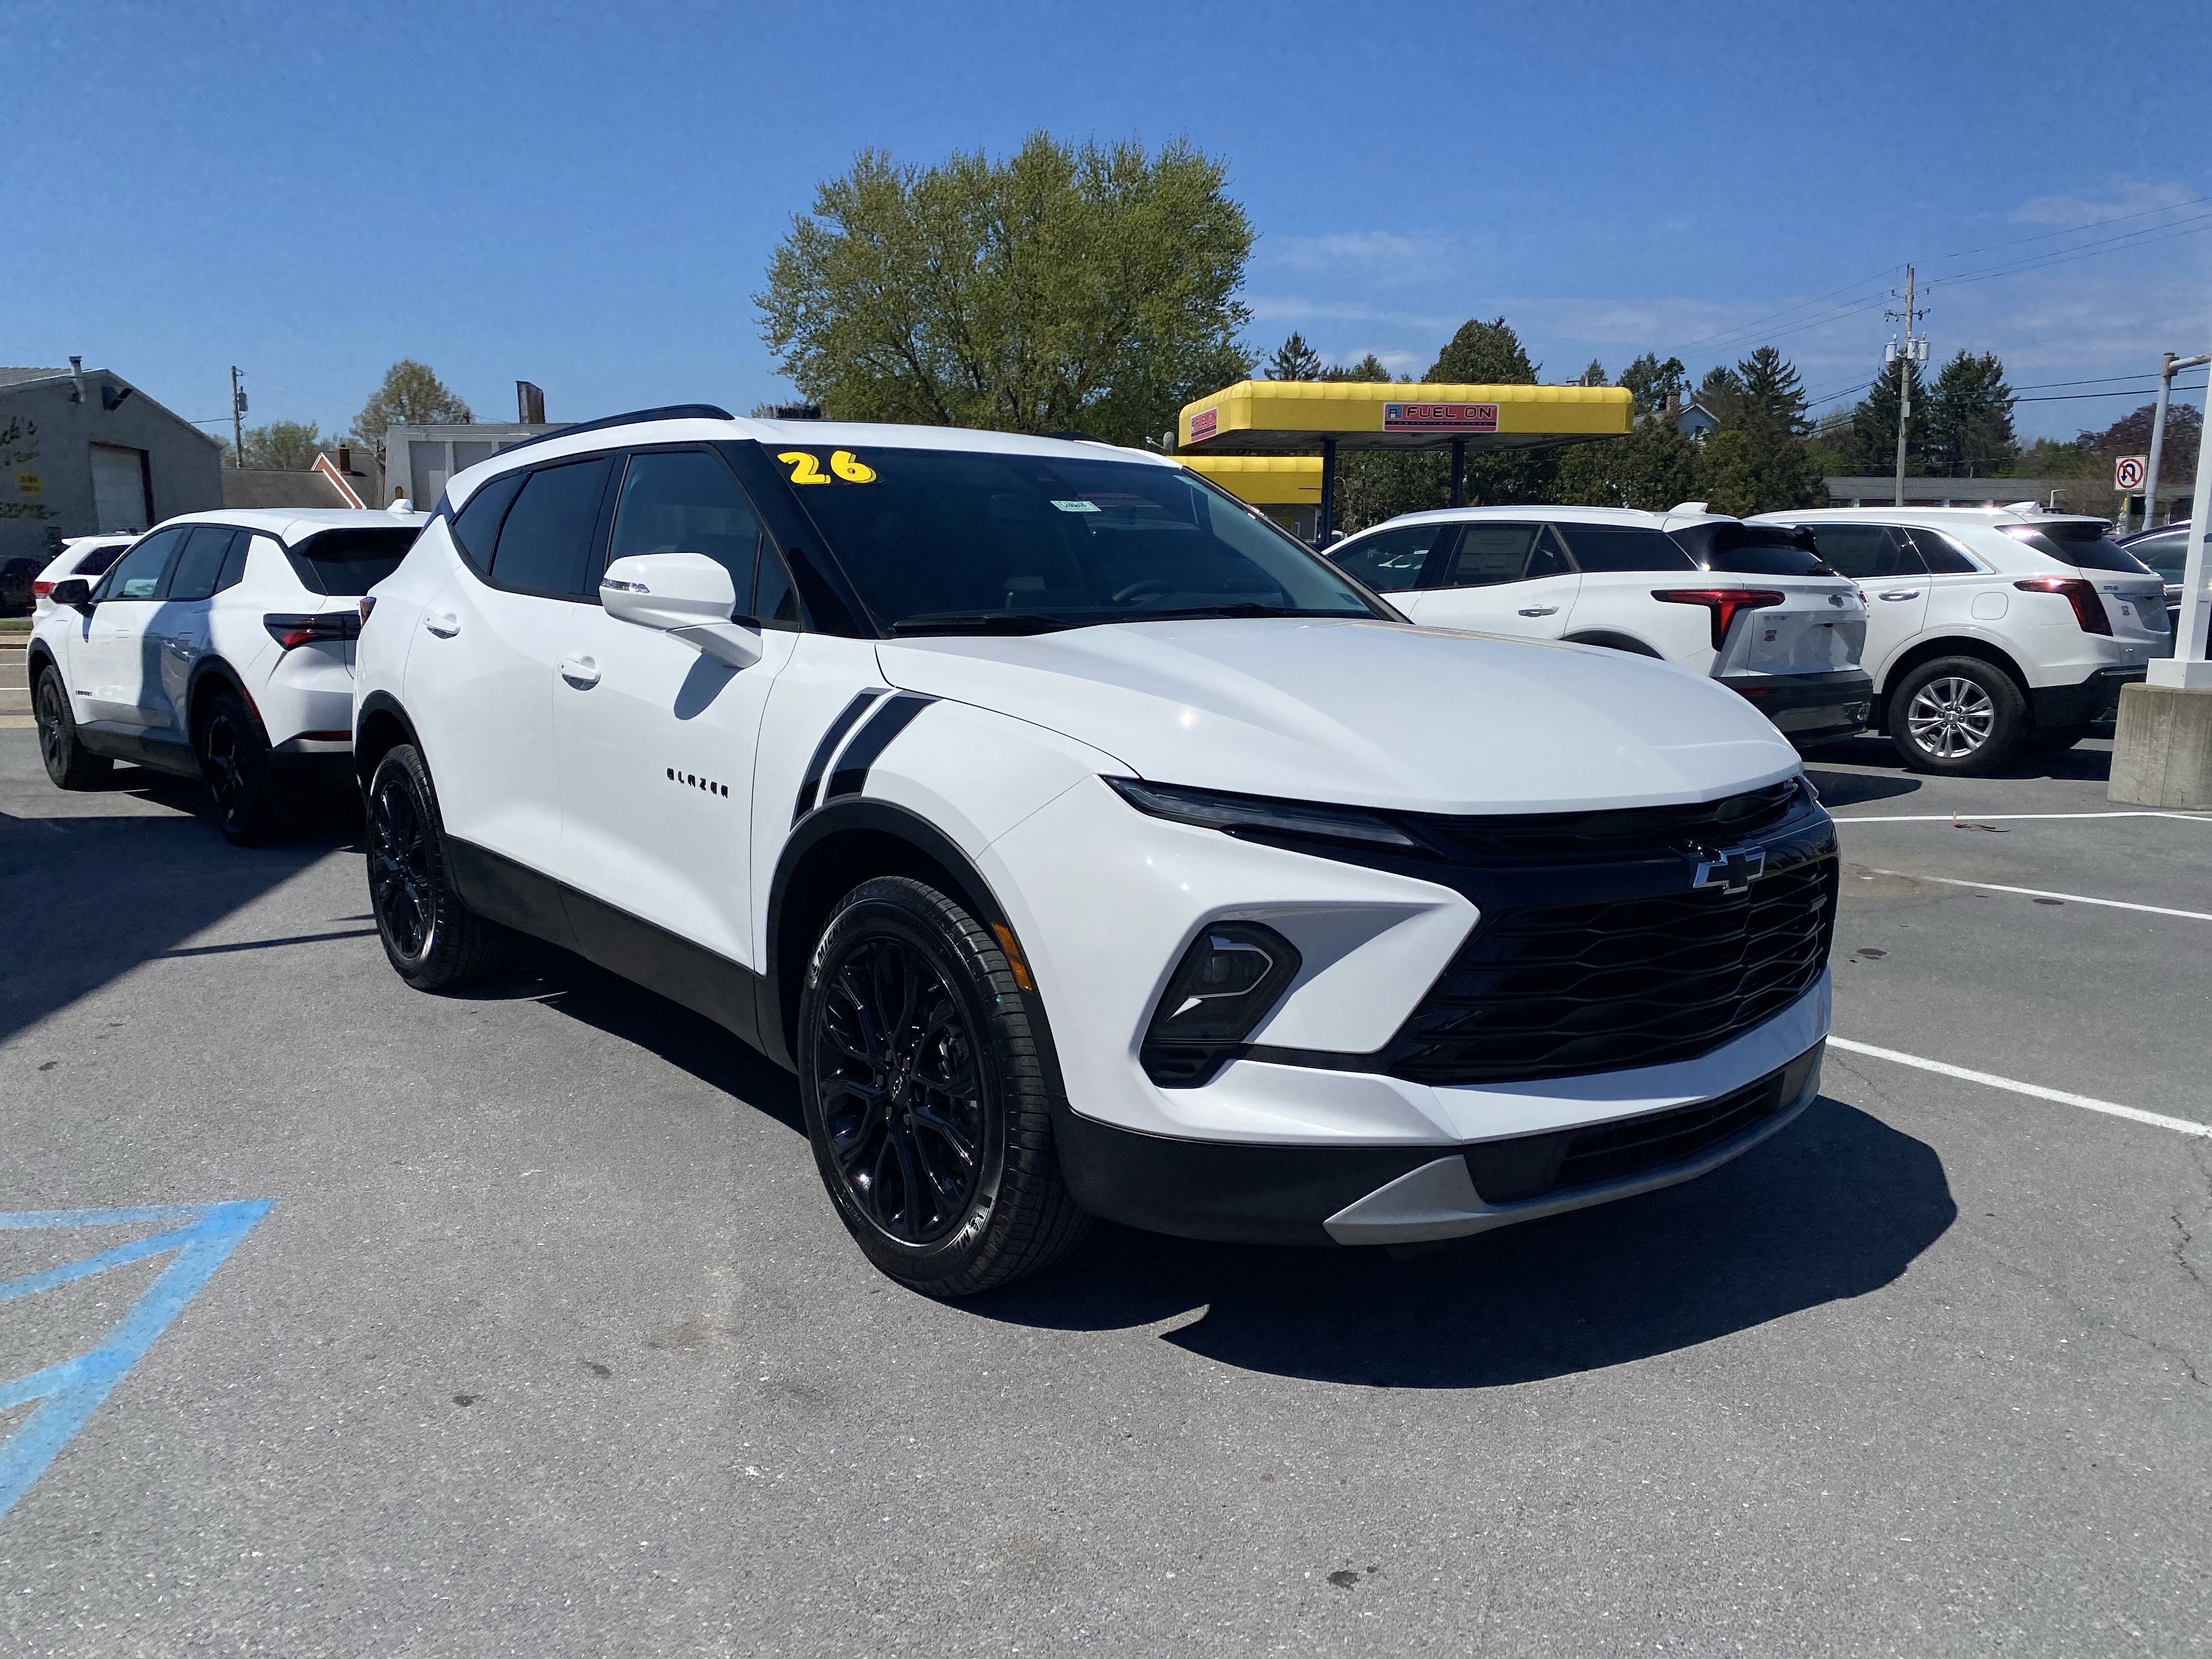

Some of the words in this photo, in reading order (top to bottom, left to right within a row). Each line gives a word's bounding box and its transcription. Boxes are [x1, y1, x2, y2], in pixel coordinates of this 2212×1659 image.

[1406, 405, 1457, 419] FUEL
[1464, 407, 1492, 419] ON
[777, 450, 877, 484] 26
[667, 768, 729, 799] BLAZER
